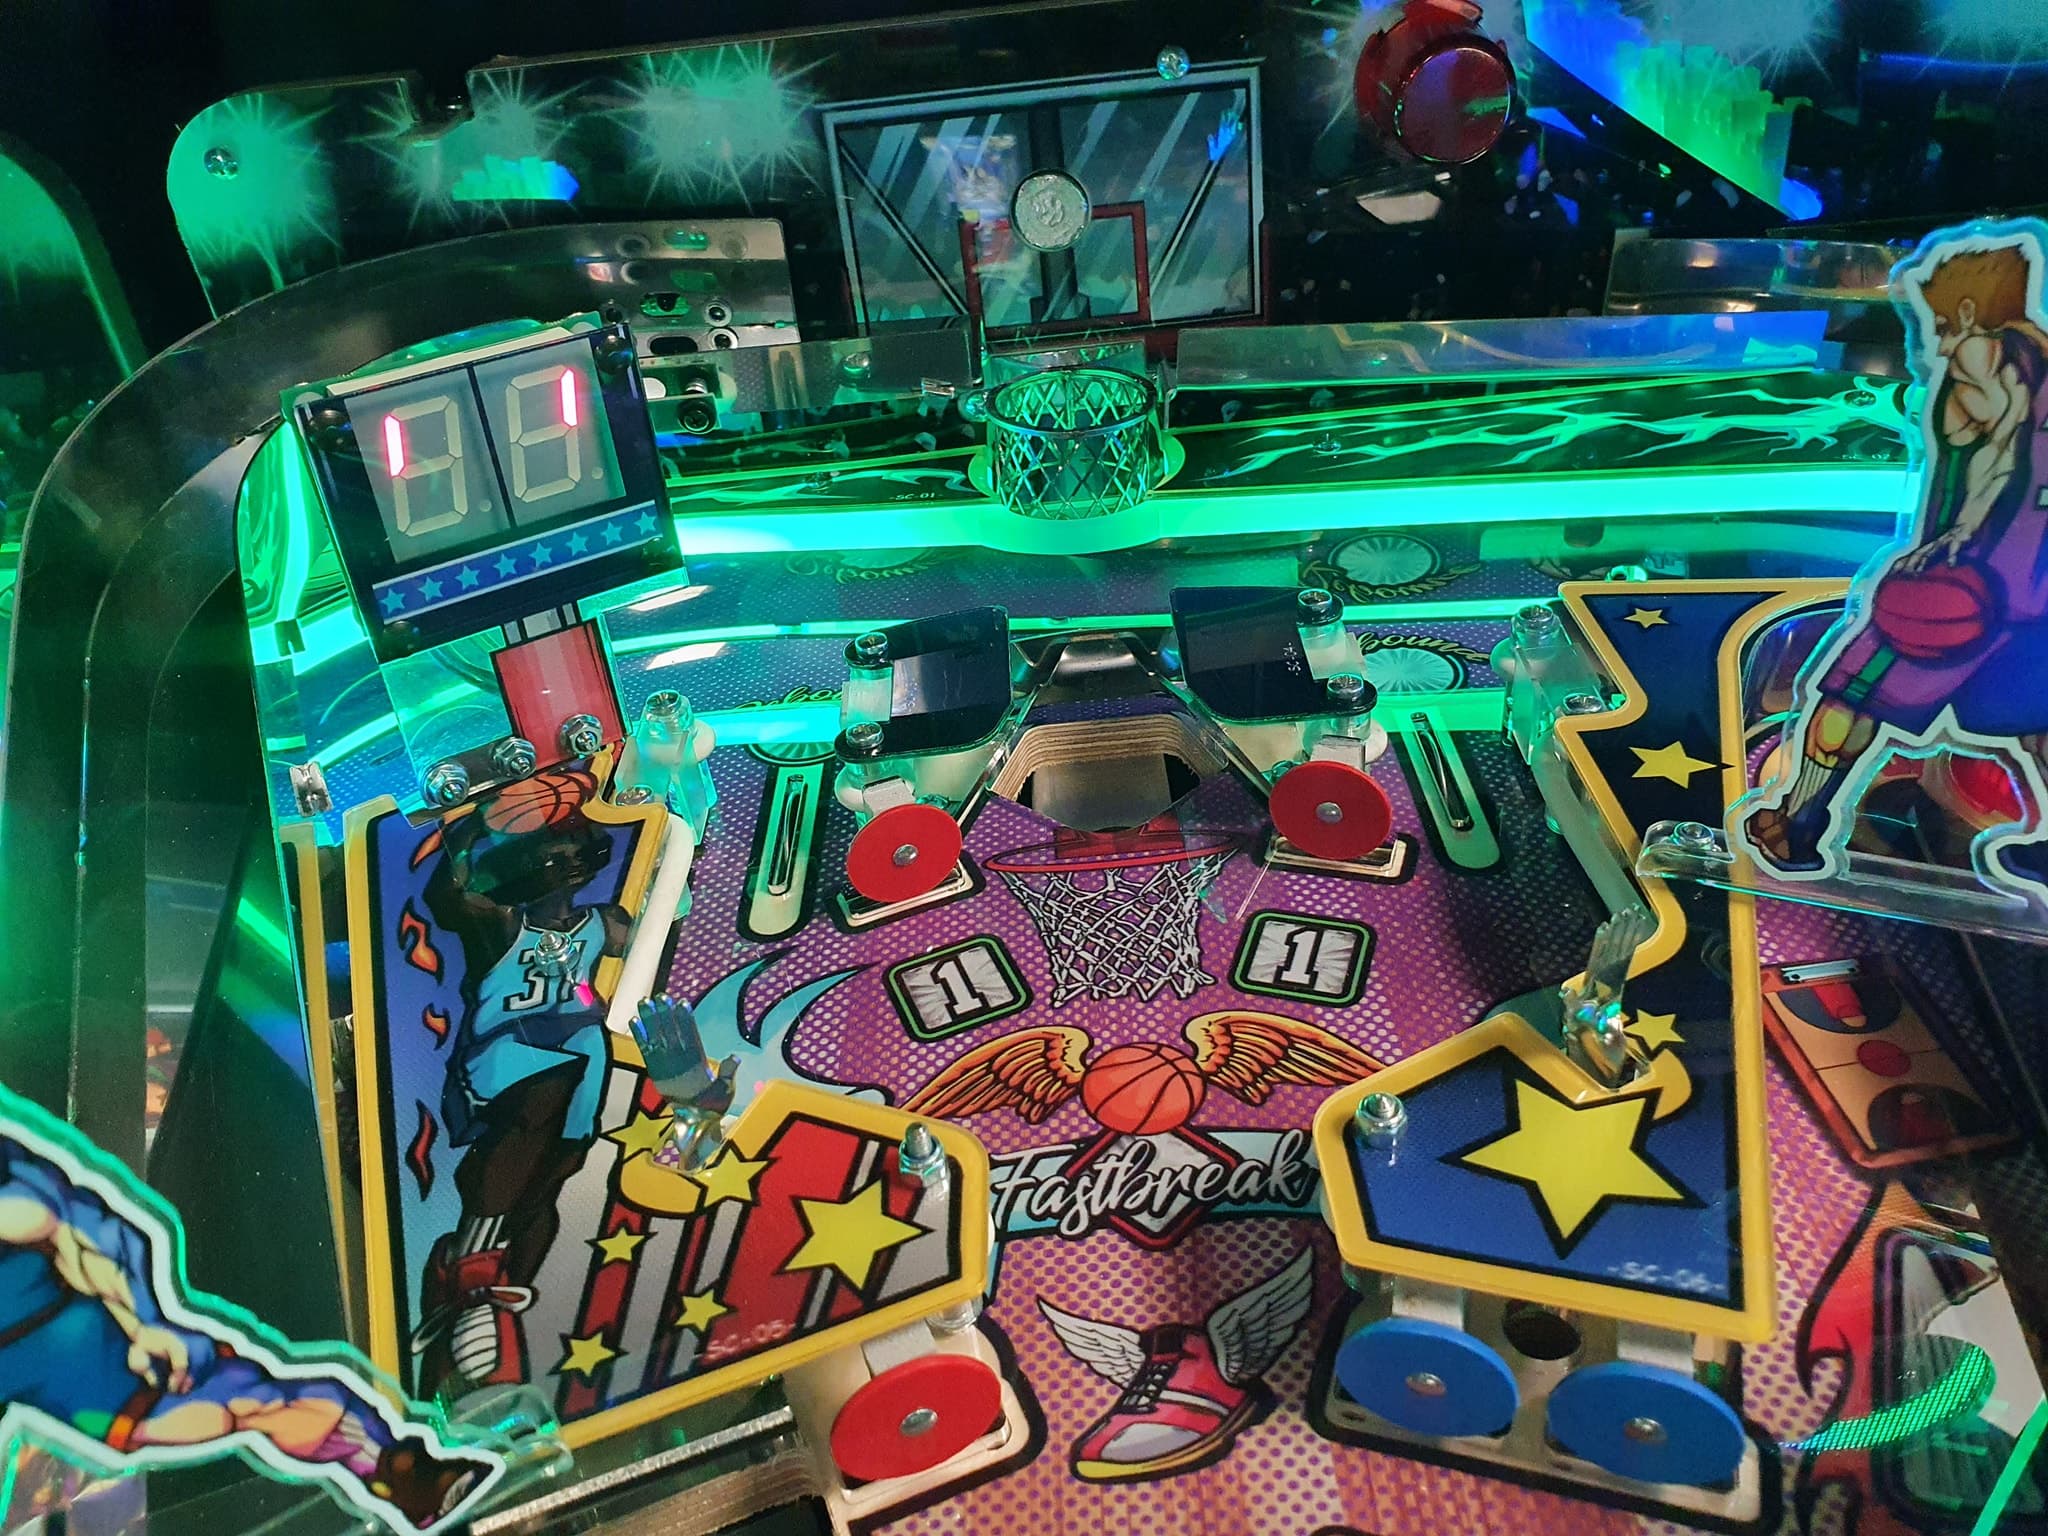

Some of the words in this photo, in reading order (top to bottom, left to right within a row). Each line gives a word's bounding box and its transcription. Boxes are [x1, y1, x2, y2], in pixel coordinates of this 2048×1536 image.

[933, 957, 987, 1019] 1
[1276, 928, 1322, 988] 1
[990, 1128, 1310, 1236] Fastbreak
